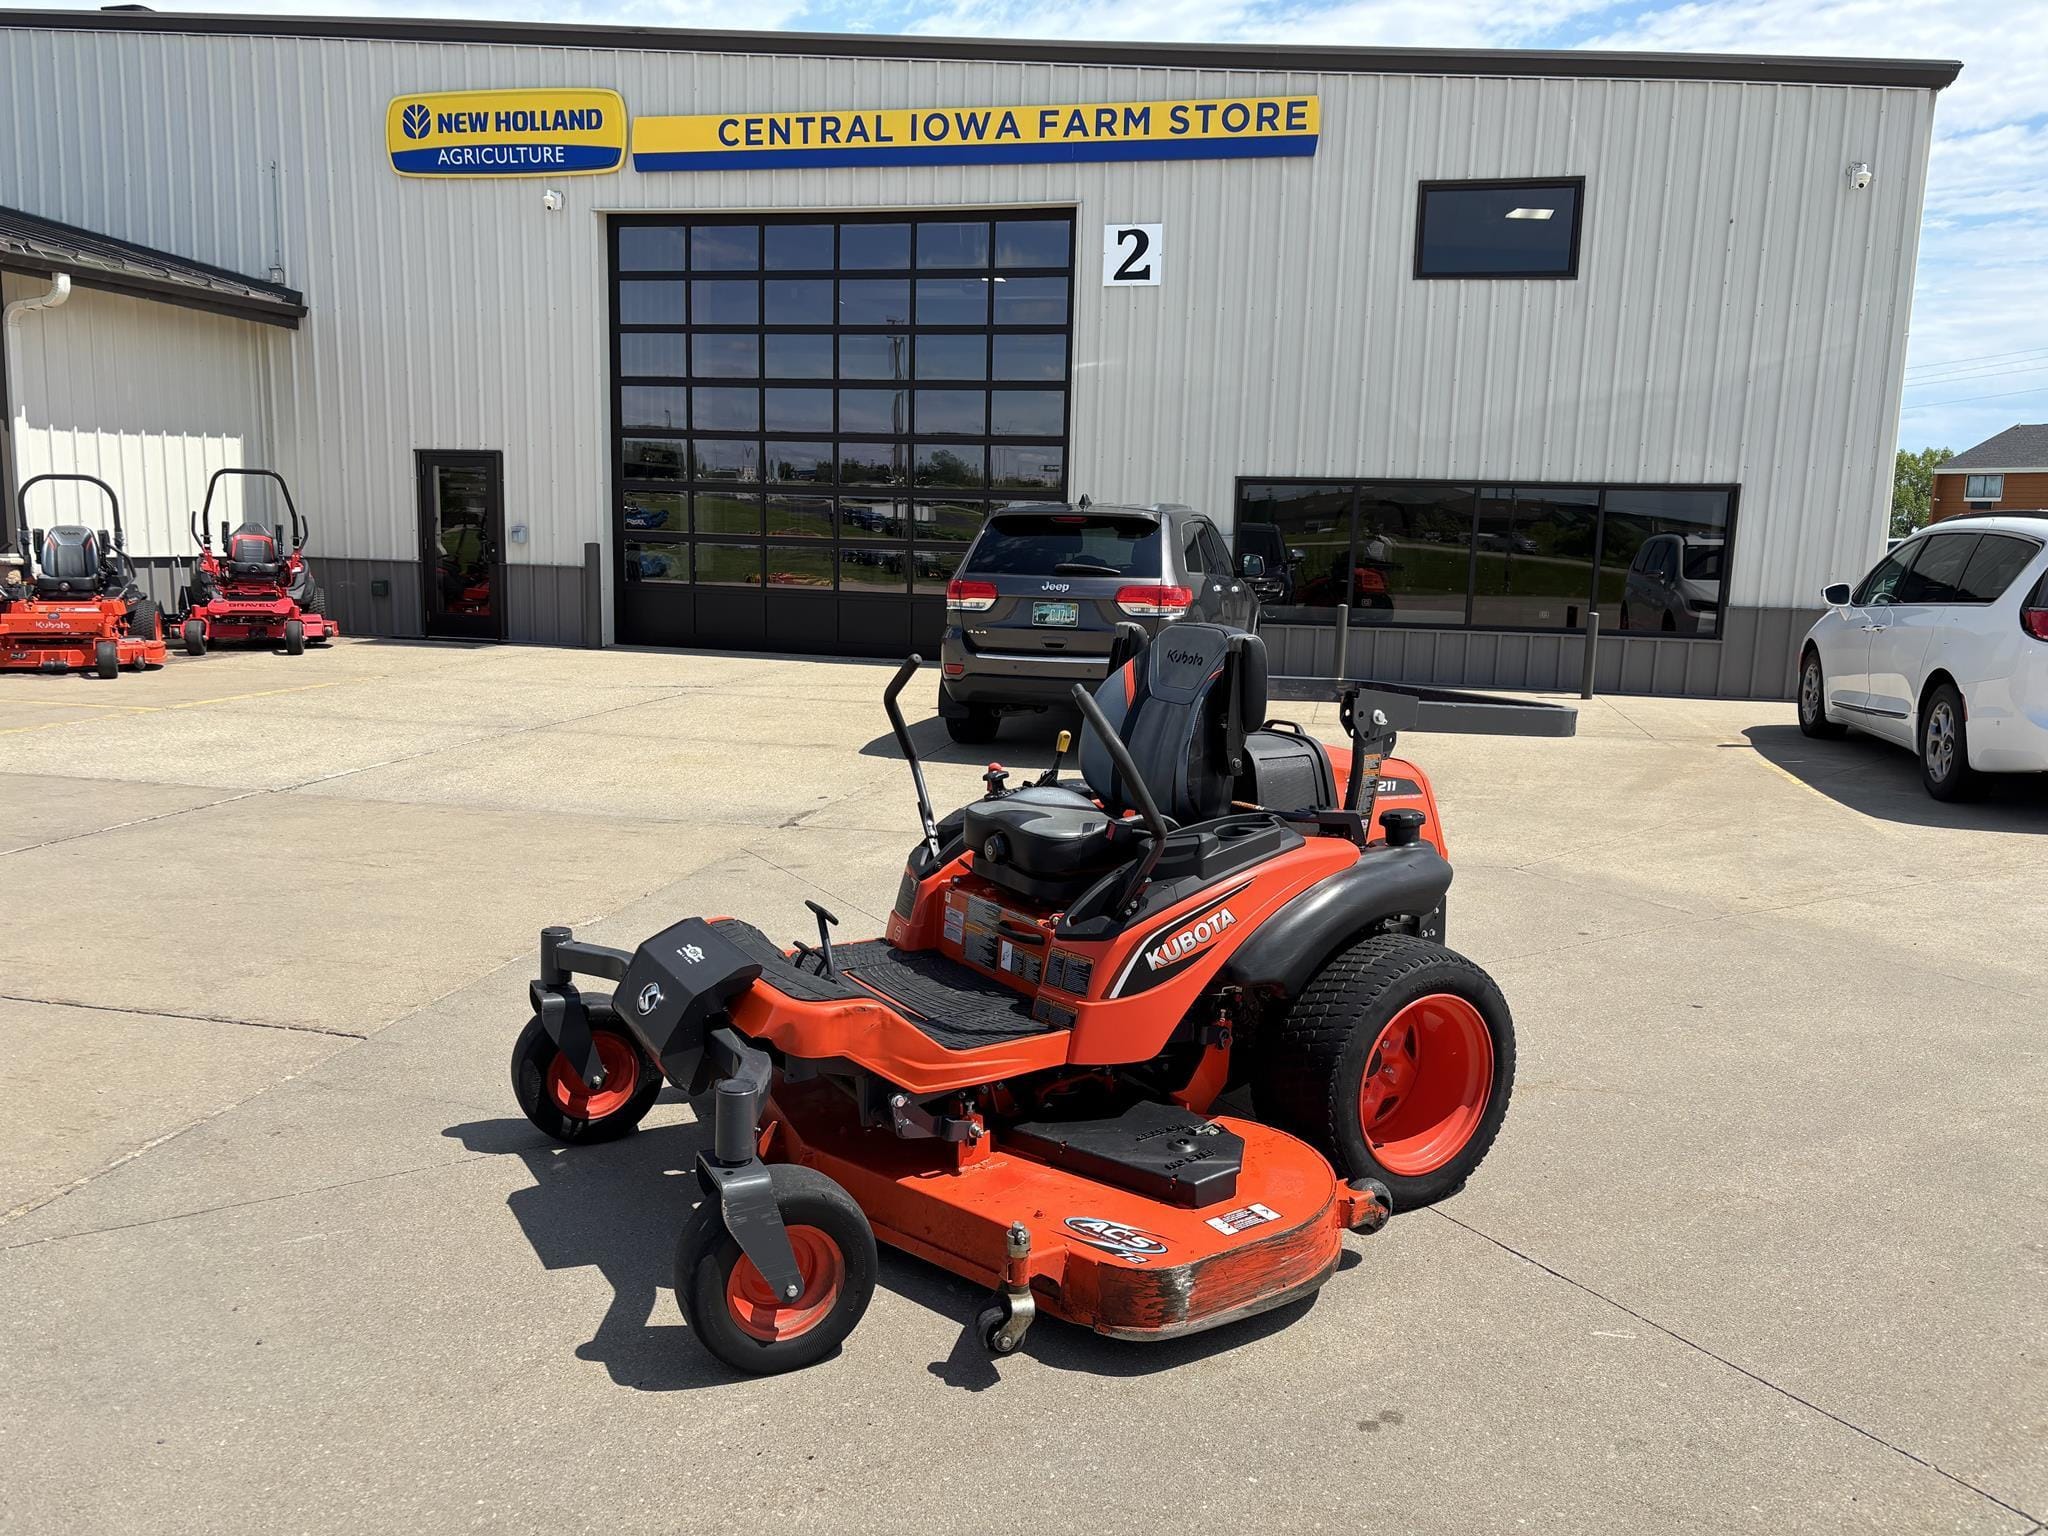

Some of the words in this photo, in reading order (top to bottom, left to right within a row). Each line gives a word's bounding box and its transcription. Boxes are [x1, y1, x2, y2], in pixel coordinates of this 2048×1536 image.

[437, 111, 489, 133] NEW
[495, 108, 603, 132] HOLLAND
[718, 115, 893, 147] CENTRAL
[910, 111, 1021, 141] IOWA
[1039, 106, 1150, 138] FARM
[1169, 100, 1308, 134] STORE
[437, 146, 565, 165] AGRICULTURE
[1113, 228, 1152, 281] 2
[1041, 581, 1070, 593] Jeep
[35, 621, 70, 629] Kubota
[1167, 649, 1204, 666] Kubota
[1145, 907, 1238, 972] KUBOTA
[1073, 1221, 1158, 1248] ACS
